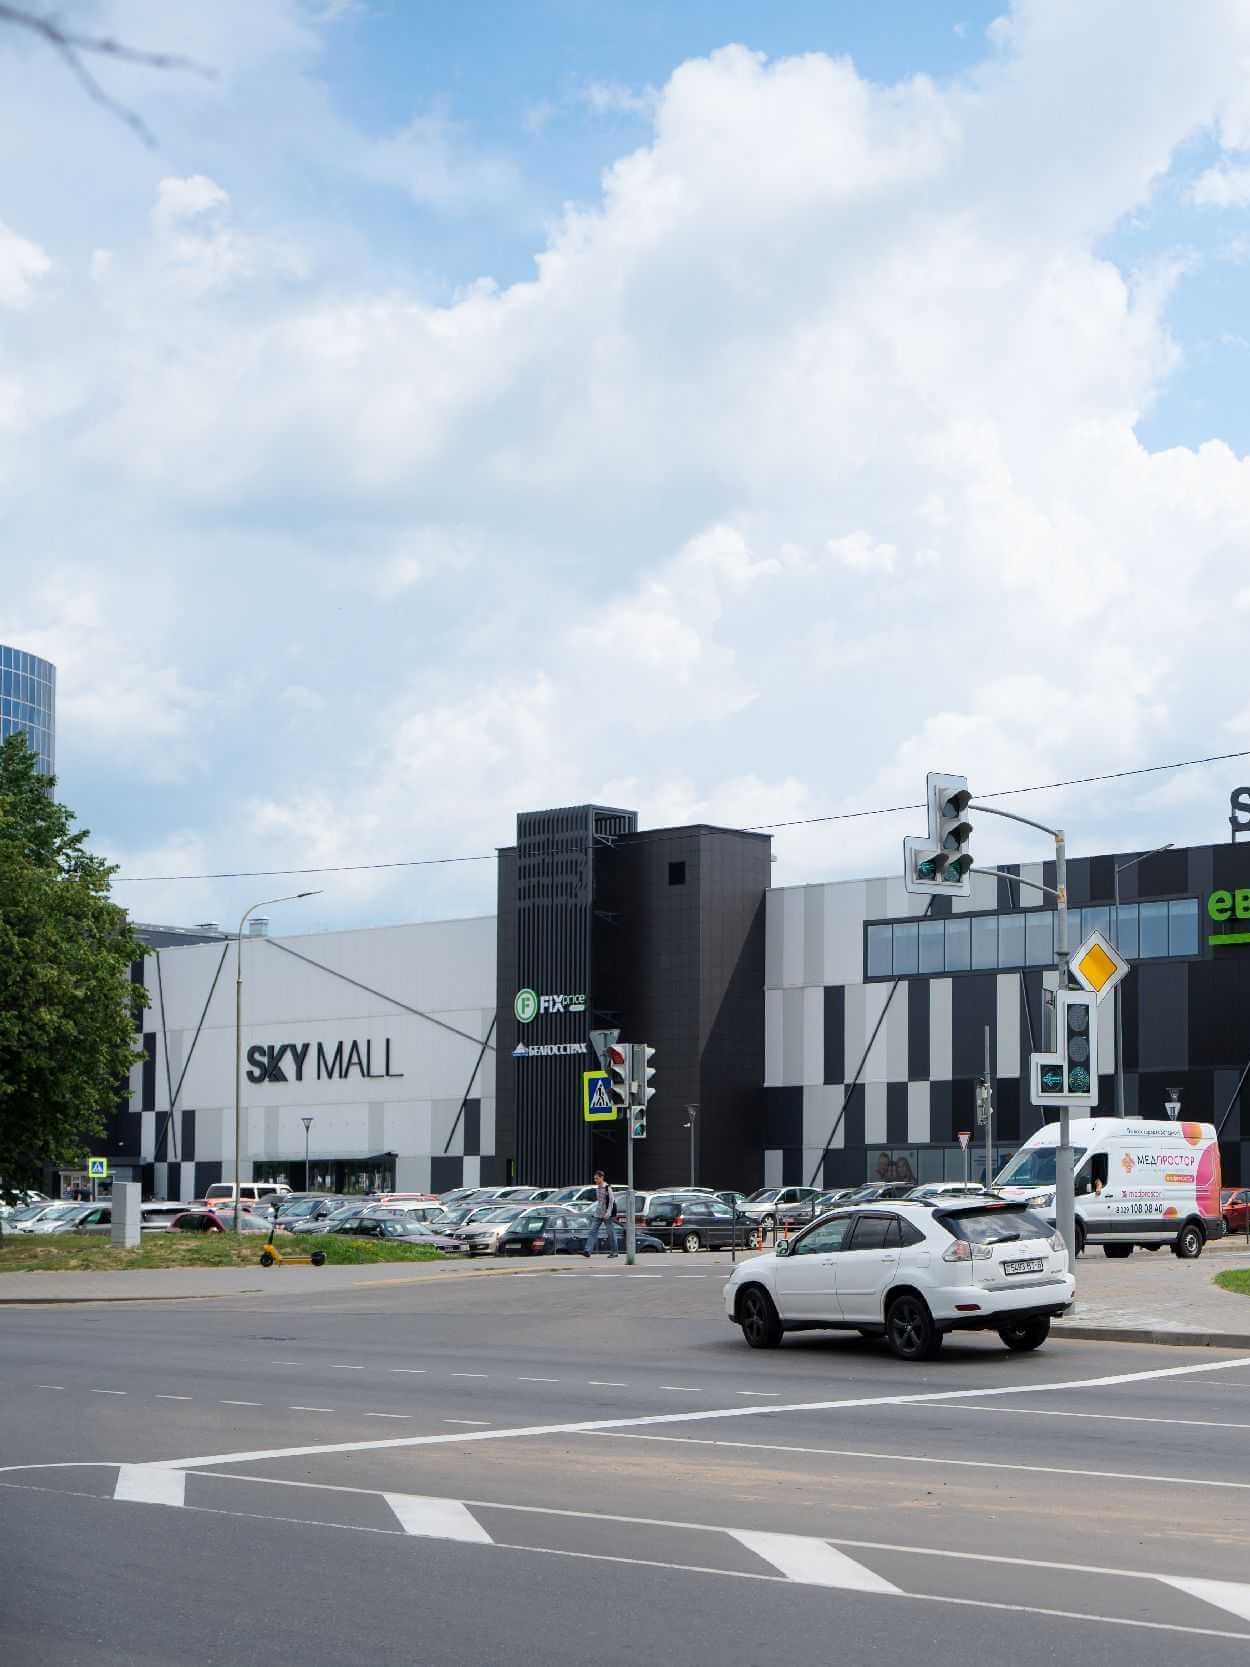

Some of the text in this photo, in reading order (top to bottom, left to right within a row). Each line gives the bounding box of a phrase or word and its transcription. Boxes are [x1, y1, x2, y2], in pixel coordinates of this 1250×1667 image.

[540, 994, 564, 1014] FIX
[246, 1037, 405, 1084] SKY MALL
[1137, 1154, 1196, 1167] МЕДПРОСТОР
